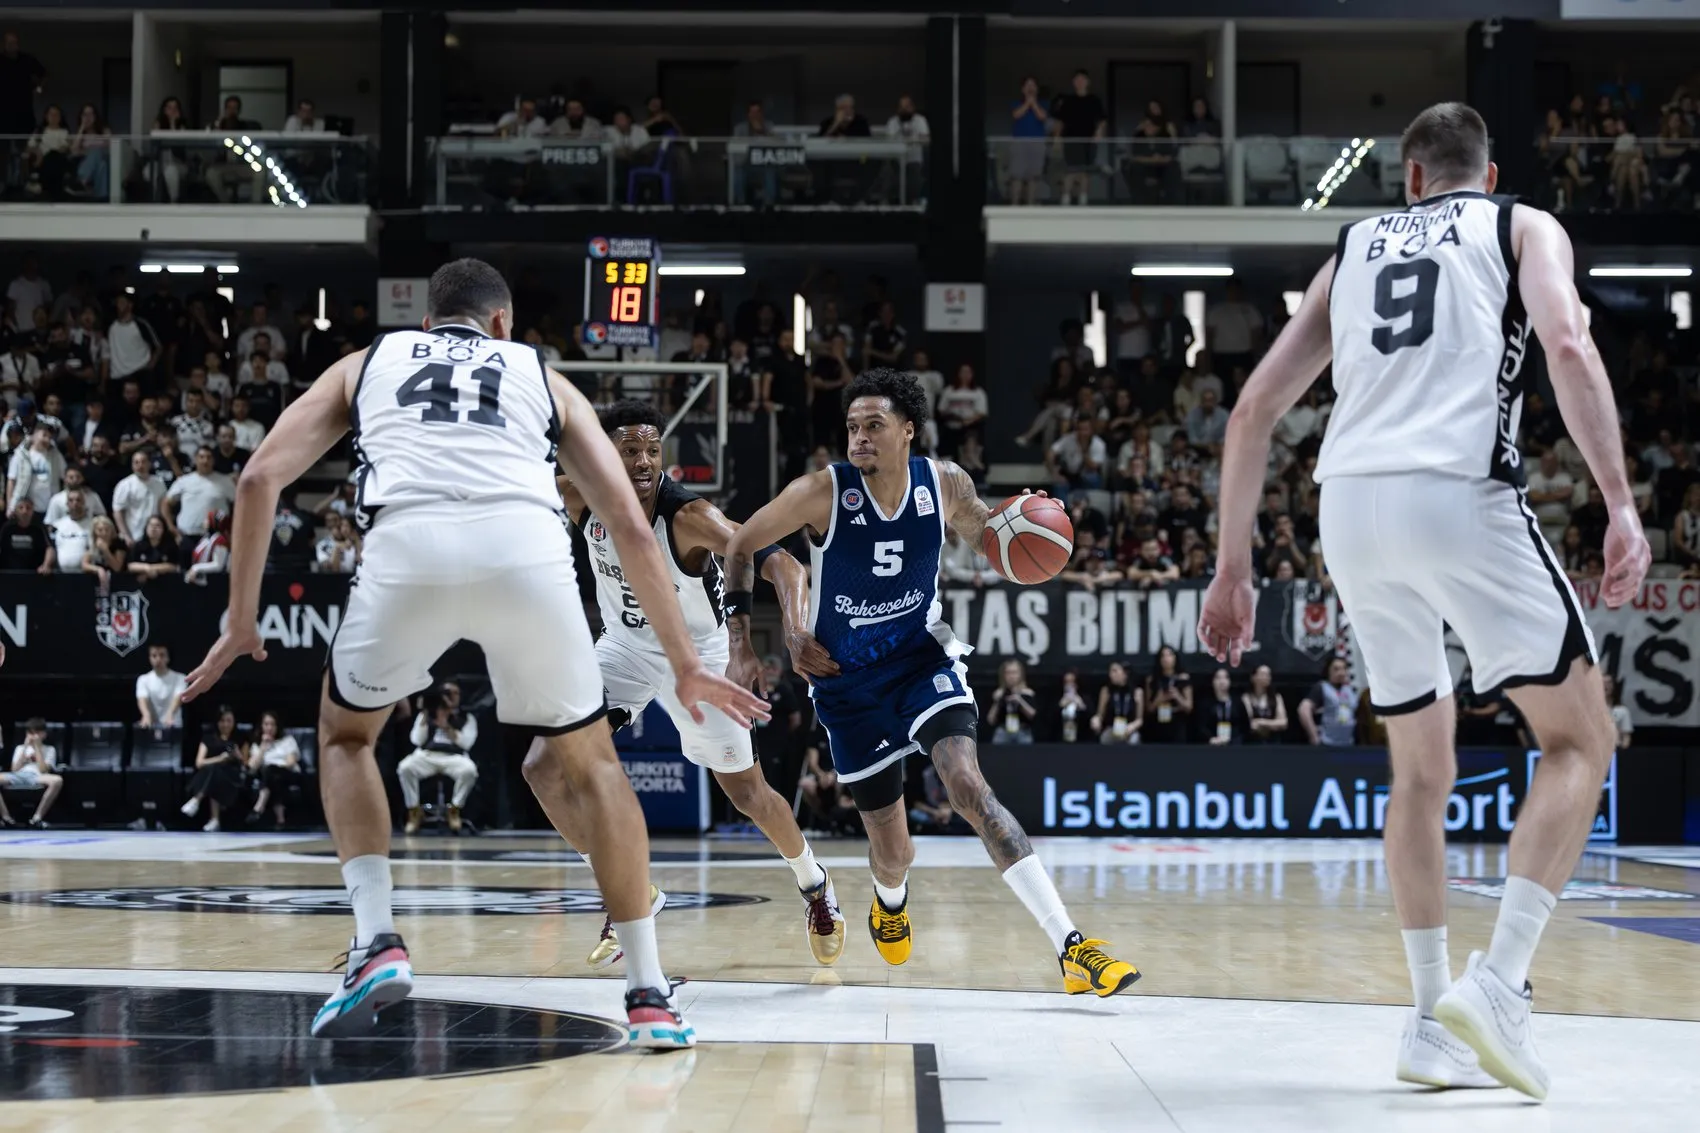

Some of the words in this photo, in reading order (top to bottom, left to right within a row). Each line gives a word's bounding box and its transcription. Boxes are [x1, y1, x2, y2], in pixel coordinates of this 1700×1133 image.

[542, 148, 599, 166] PRESS
[751, 148, 806, 166] BASIN
[1374, 201, 1467, 234] MORGAN
[605, 262, 619, 284] 5
[623, 262, 648, 284] 33
[610, 286, 642, 322] 18
[1371, 258, 1441, 355] 9
[395, 362, 507, 428] 41
[872, 540, 904, 577] 5
[834, 588, 925, 618] Bahçeşehir
[941, 587, 1050, 666] TAŞ
[1043, 776, 1290, 831] Istanbul
[1308, 777, 1517, 831] Airort
